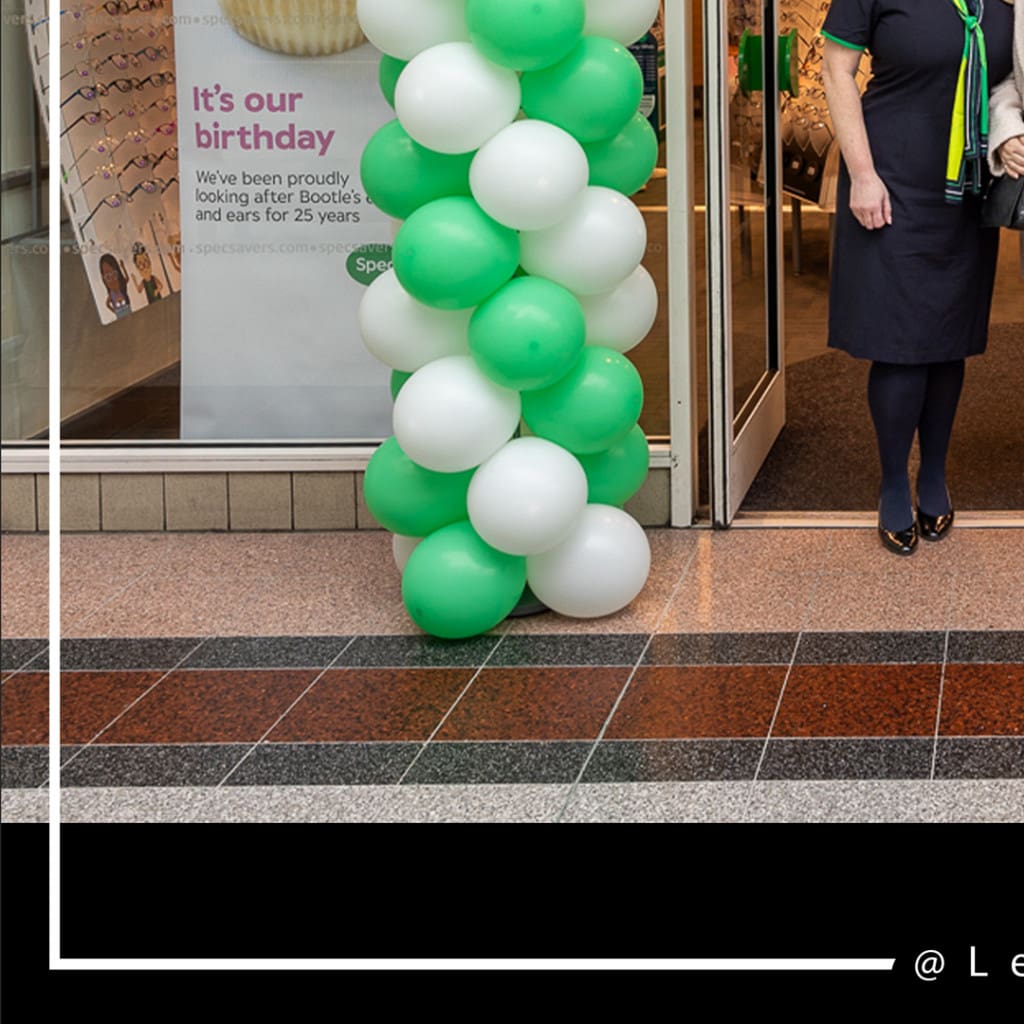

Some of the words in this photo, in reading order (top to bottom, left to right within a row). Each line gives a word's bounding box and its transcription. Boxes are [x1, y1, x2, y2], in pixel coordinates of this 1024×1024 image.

[193, 83, 235, 113] It's
[244, 92, 304, 113] our
[194, 121, 336, 157] birthday
[196, 170, 237, 185] We've
[242, 171, 282, 185] been
[287, 171, 350, 188] proudly
[195, 188, 249, 207] looking
[254, 189, 294, 204] after
[300, 189, 361, 204] Bootle's
[195, 208, 222, 222] and
[226, 210, 261, 222] ears
[265, 207, 289, 222] for
[294, 208, 313, 222] 25
[318, 210, 361, 224] years
